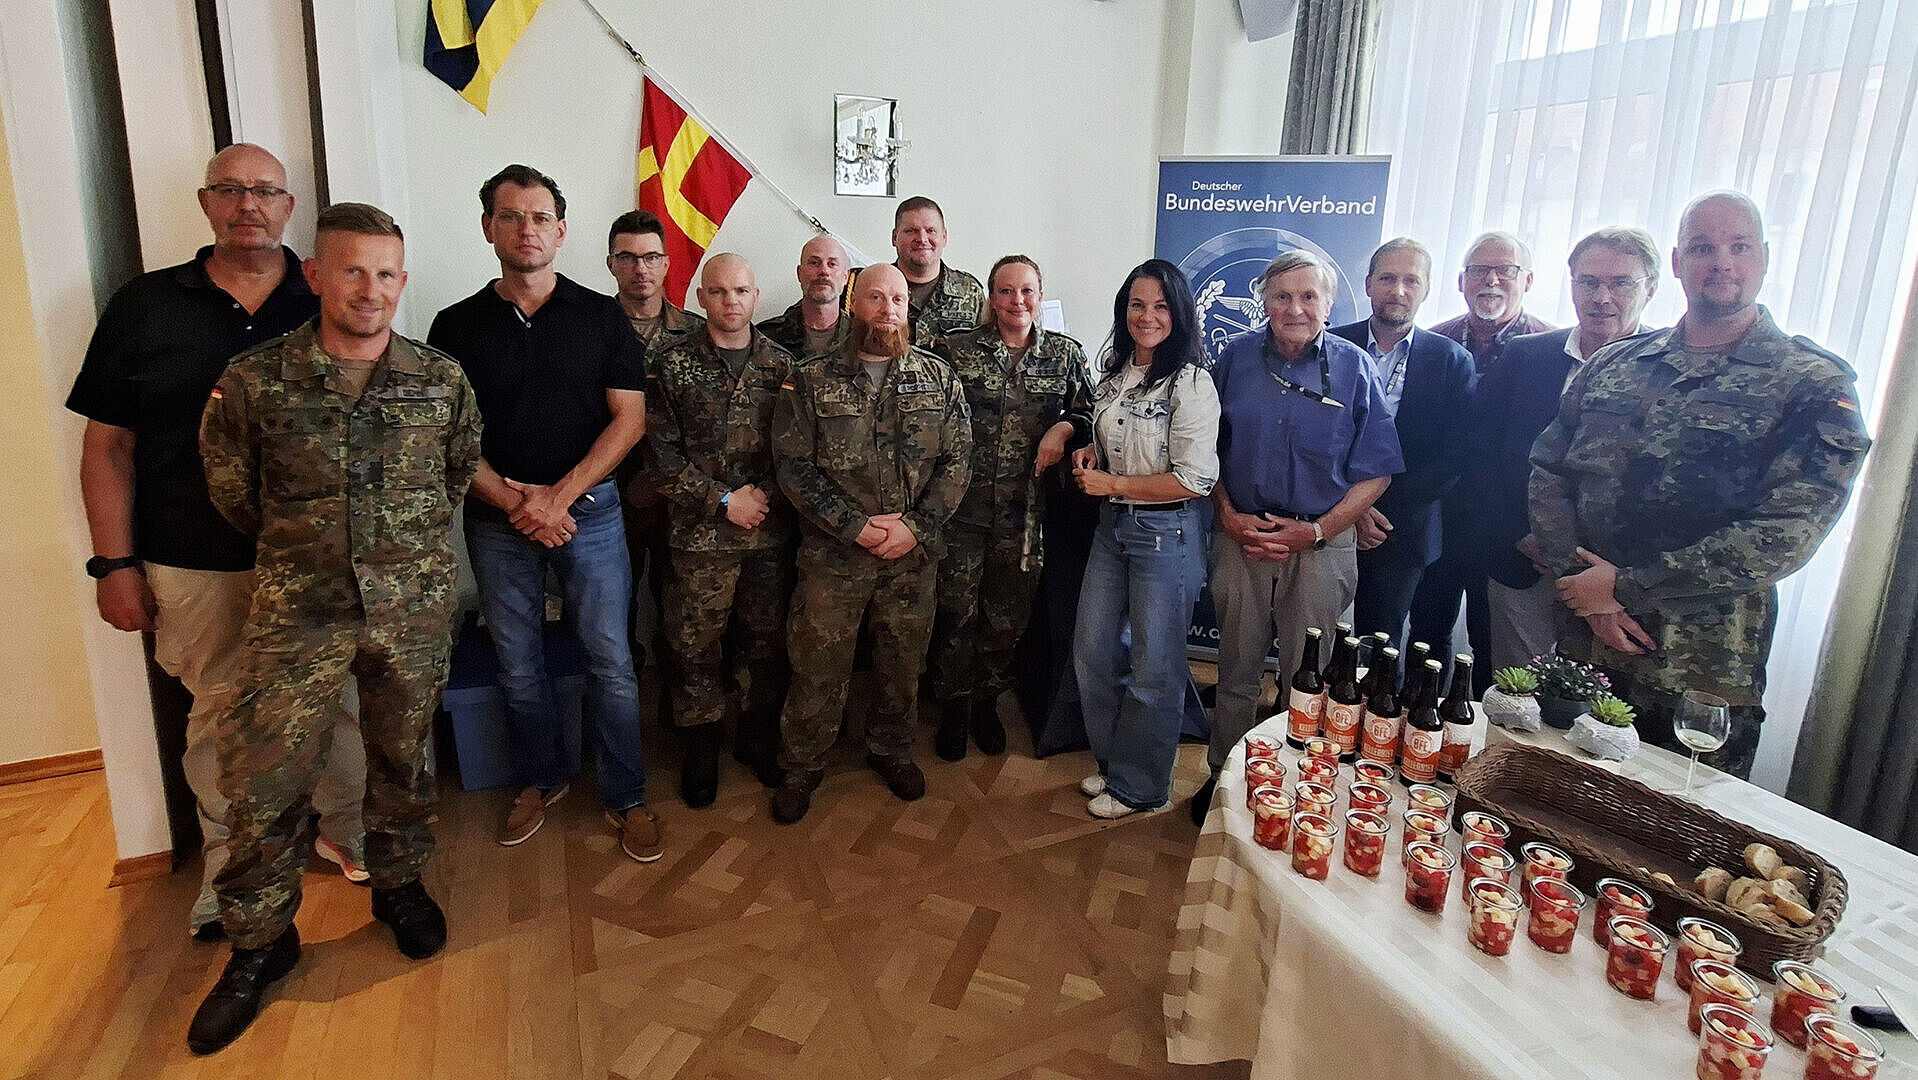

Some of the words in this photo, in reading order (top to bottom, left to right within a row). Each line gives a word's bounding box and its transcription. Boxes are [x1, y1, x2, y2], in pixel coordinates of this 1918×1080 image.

[1192, 180, 1243, 191] Deutscher
[1165, 193, 1377, 216] BundeswehrVerband
[1374, 724, 1389, 738] BFE
[1413, 738, 1429, 752] BFE
